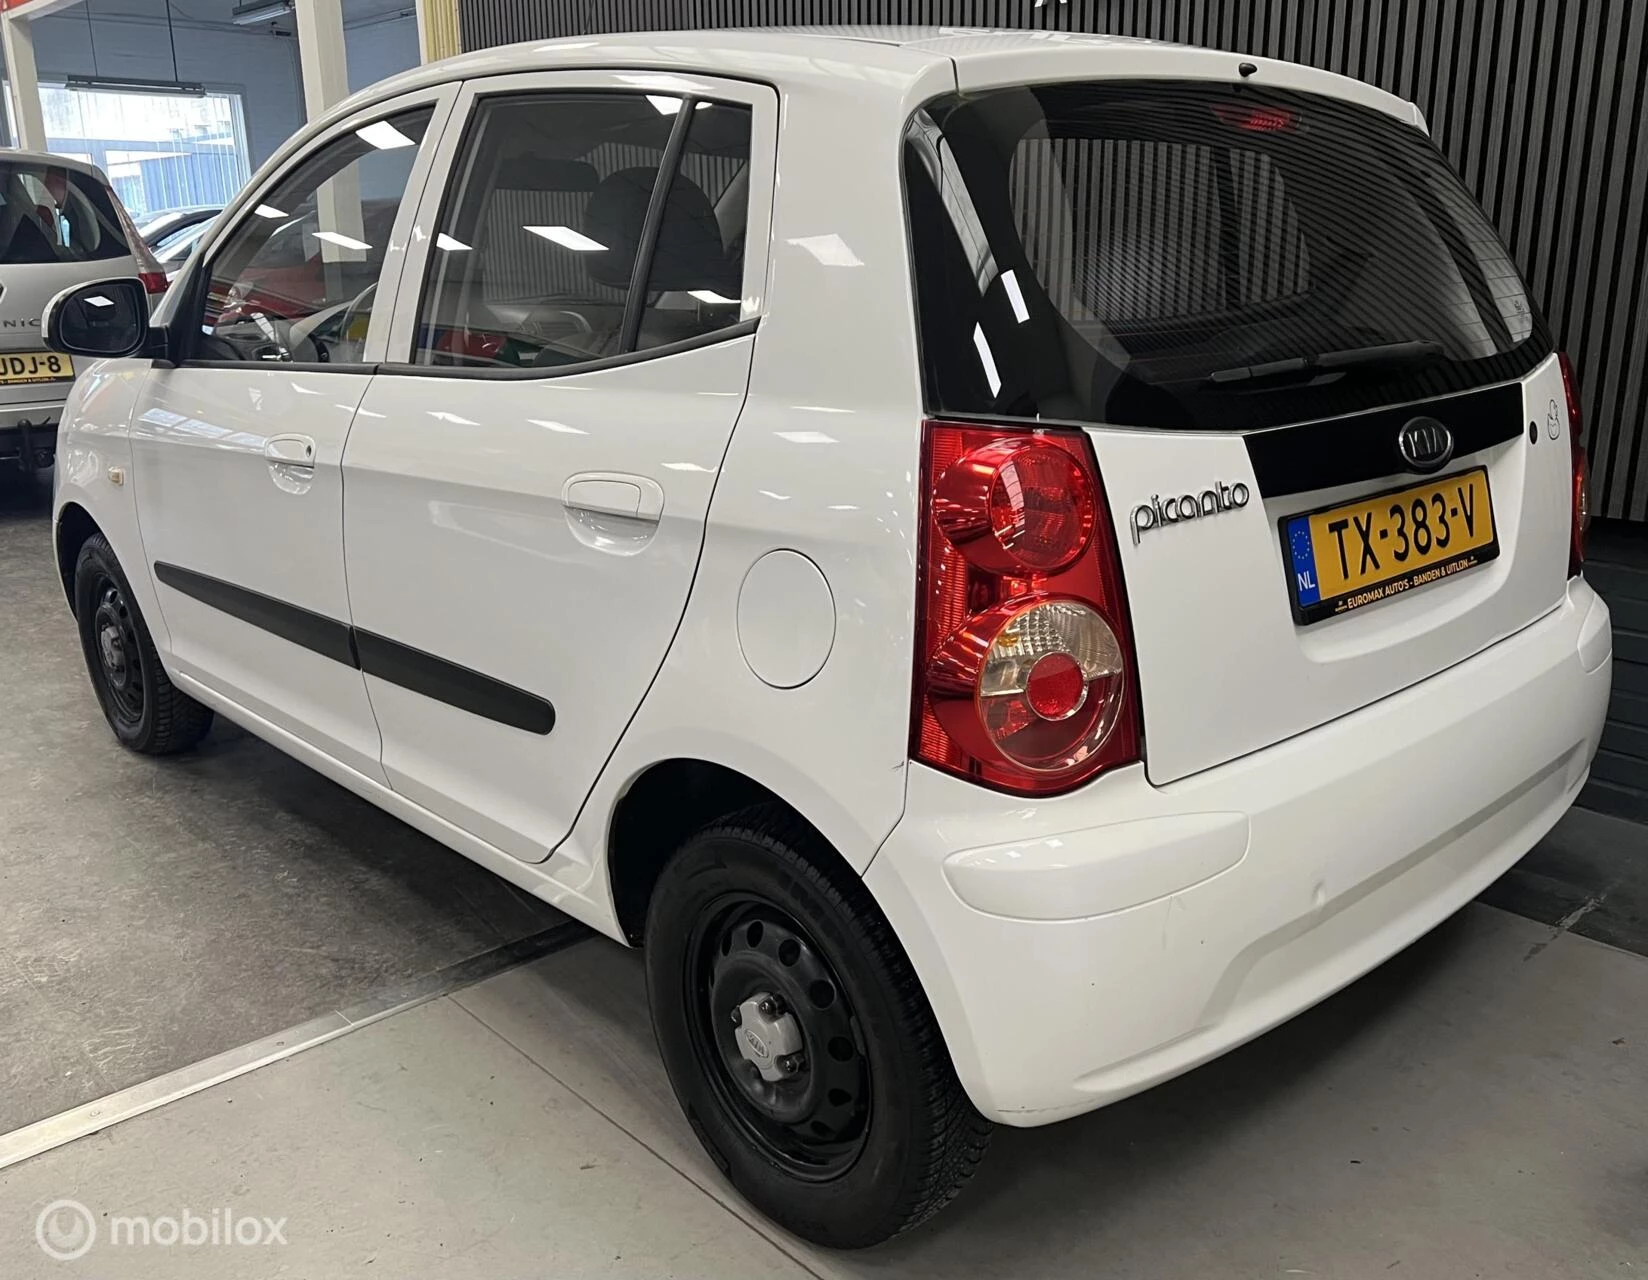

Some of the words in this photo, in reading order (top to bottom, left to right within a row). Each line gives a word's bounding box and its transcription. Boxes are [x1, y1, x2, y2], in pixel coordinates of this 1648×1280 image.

[1130, 481, 1250, 545] picanto
[1328, 484, 1474, 580] TX-383-V
[1297, 571, 1316, 591] NL
[1347, 588, 1384, 609] EUROMAX
[1384, 579, 1409, 595] AUTO'S
[1413, 570, 1440, 586] BANDEN
